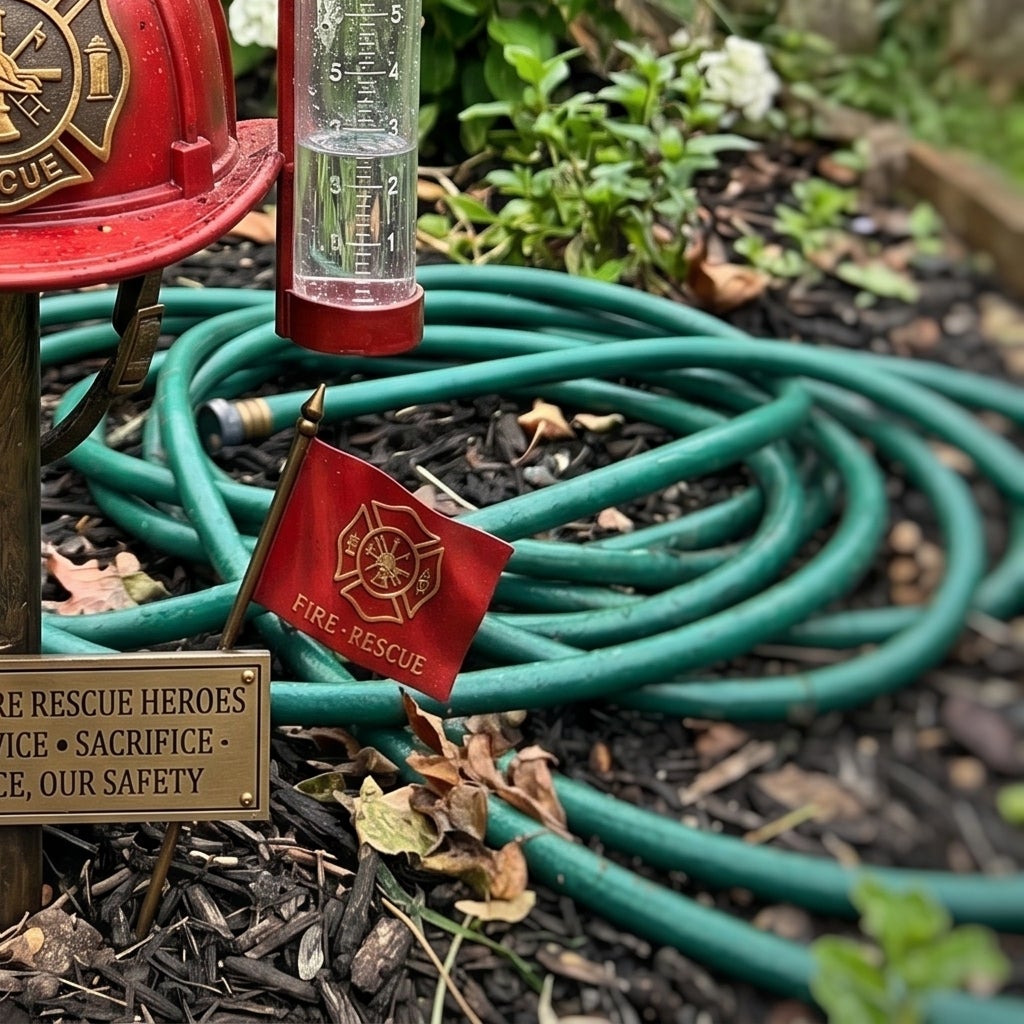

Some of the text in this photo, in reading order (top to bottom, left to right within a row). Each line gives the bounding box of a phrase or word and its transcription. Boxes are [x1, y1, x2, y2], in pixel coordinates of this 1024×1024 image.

[390, 4, 402, 24] 5
[329, 62, 399, 81] 5 4
[388, 118, 399, 136] 3
[388, 176, 399, 195] 2
[387, 232, 394, 252] 1
[291, 593, 427, 676] FIRE RESCUE
[30, 688, 135, 718] RESCUE
[139, 686, 247, 716] HEROES
[74, 727, 214, 758] SACRIFICE
[39, 770, 97, 797] OUR
[102, 767, 206, 796] SAFETY
